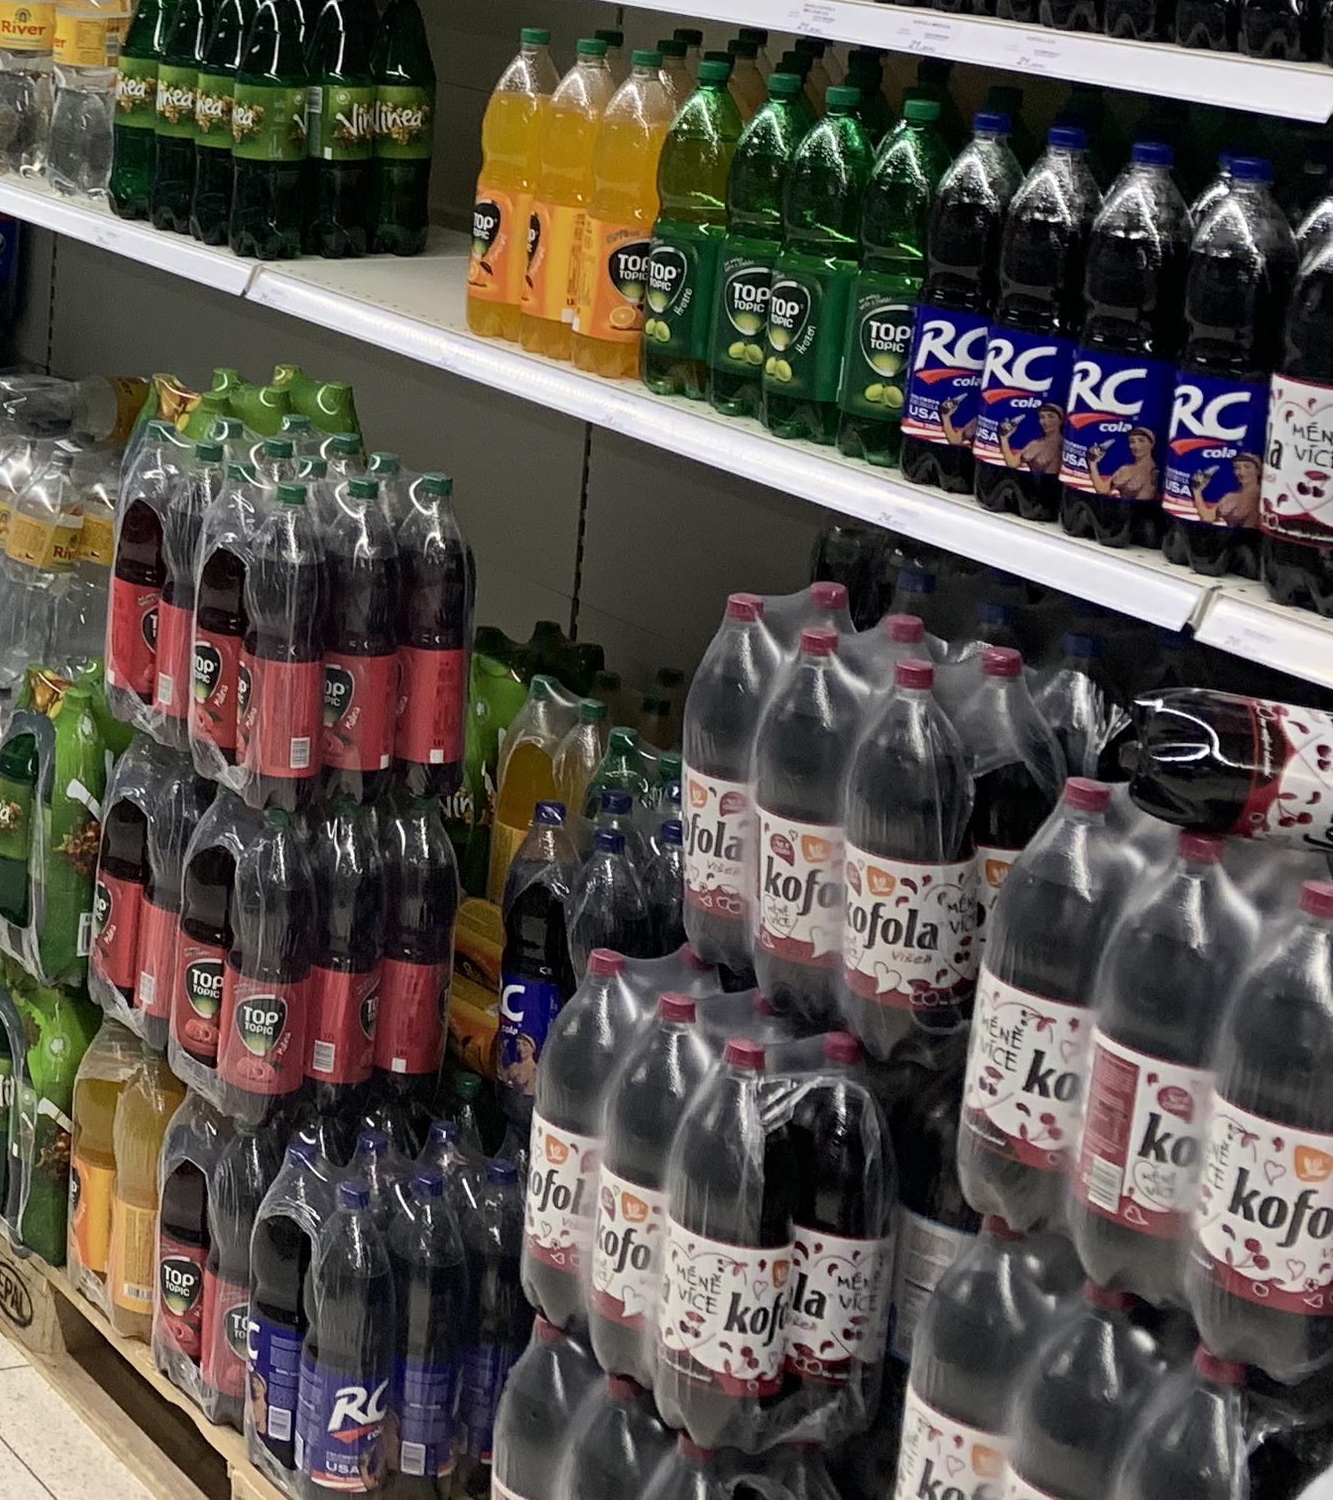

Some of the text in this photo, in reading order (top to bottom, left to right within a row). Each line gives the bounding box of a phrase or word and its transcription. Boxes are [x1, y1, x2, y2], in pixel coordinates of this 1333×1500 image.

[0, 19, 47, 37] River
[649, 260, 678, 279] TOP
[733, 282, 770, 302] TOP
[771, 295, 800, 317] TOP
[795, 324, 817, 356] Hrozen
[869, 320, 911, 341] TOP
[916, 319, 988, 370] RC
[982, 338, 1059, 391] RC
[1067, 360, 1148, 416] RC
[1010, 396, 1043, 409] cola
[1169, 383, 1252, 442] RC
[908, 405, 941, 423] USA
[1099, 420, 1133, 434] cola
[1292, 424, 1333, 446] MÉN
[1202, 445, 1237, 460] cola
[192, 968, 223, 990] TOP
[500, 984, 525, 1020] C
[243, 1006, 279, 1026] TOP
[164, 1266, 195, 1289] TOP
[327, 1378, 390, 1431] RC
